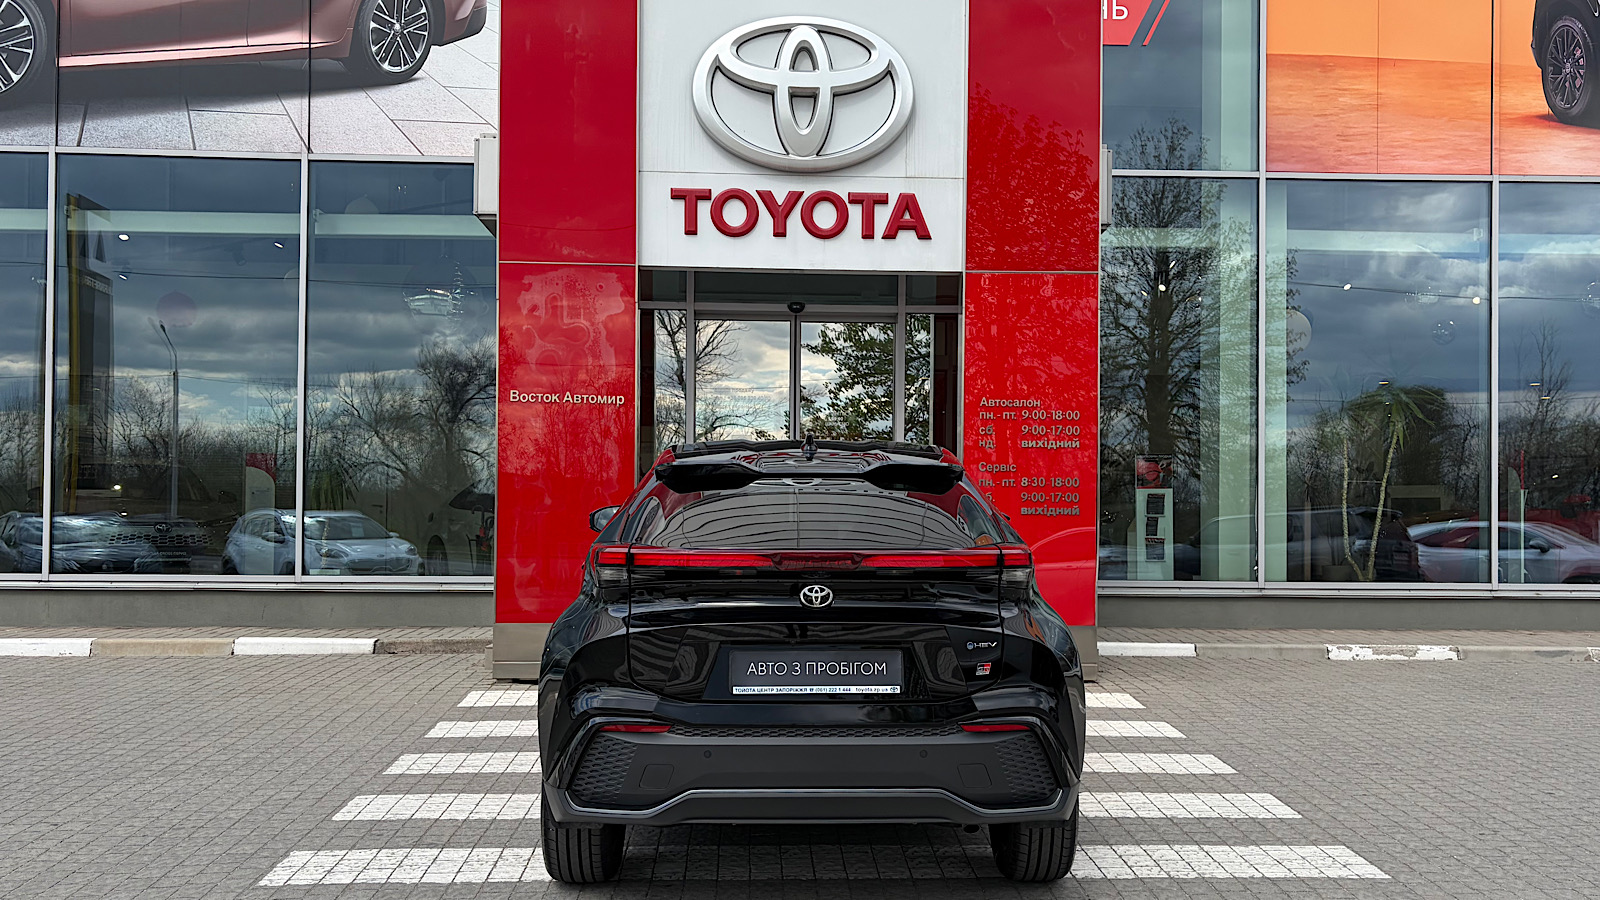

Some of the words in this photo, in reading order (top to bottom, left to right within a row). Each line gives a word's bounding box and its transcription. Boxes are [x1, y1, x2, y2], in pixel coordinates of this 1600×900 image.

[670, 187, 932, 240] TOYOTA
[509, 389, 560, 403] Восток
[562, 391, 625, 407] Автомир
[980, 397, 1040, 407] Автосалон
[1021, 425, 1080, 435] 9:00-17:00
[1021, 438, 1080, 449] вихідний
[979, 462, 1017, 474] Сервіс
[1021, 492, 1080, 502] 9:00-17:00
[1021, 505, 1080, 516] вихідний
[746, 661, 788, 676] АВТО
[791, 661, 801, 676] З
[805, 661, 887, 676] ПРОБІГОМ
